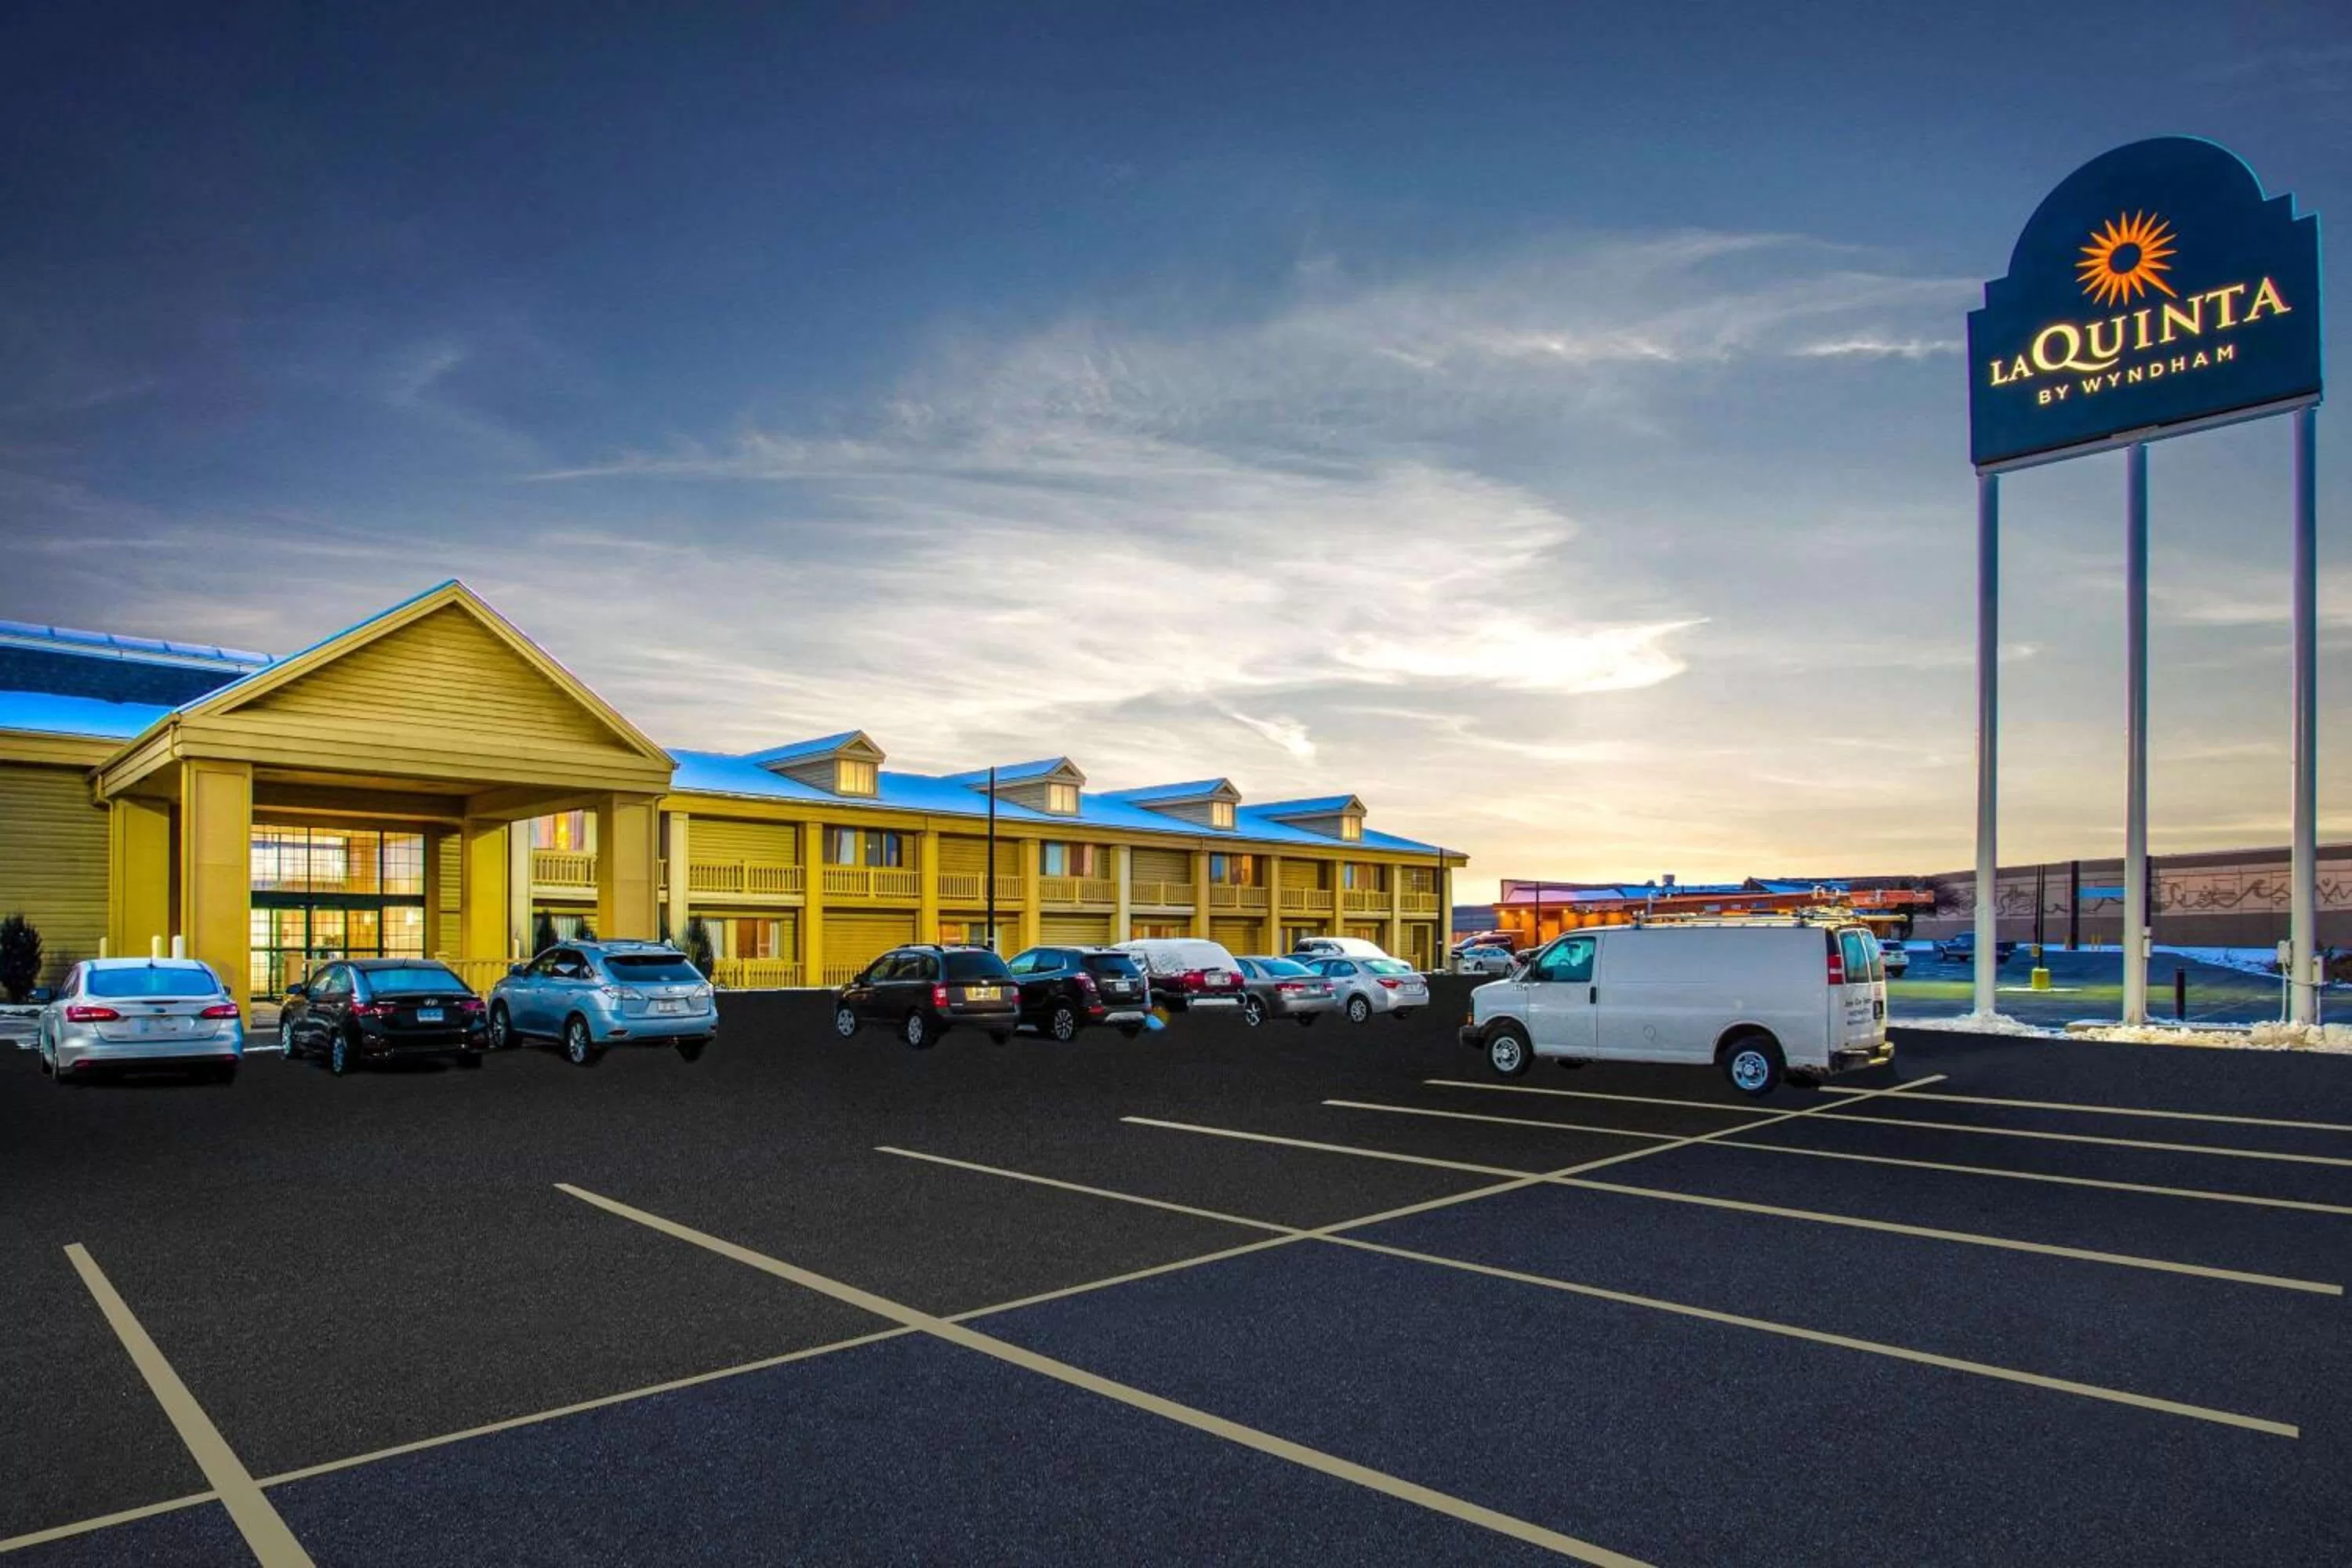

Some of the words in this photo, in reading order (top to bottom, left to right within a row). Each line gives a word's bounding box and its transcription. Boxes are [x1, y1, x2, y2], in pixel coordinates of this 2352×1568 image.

[1990, 354, 2034, 386] LA
[2032, 277, 2292, 371] QUINTA
[2038, 384, 2069, 405] BY
[2082, 345, 2234, 394] WYNDHAM
